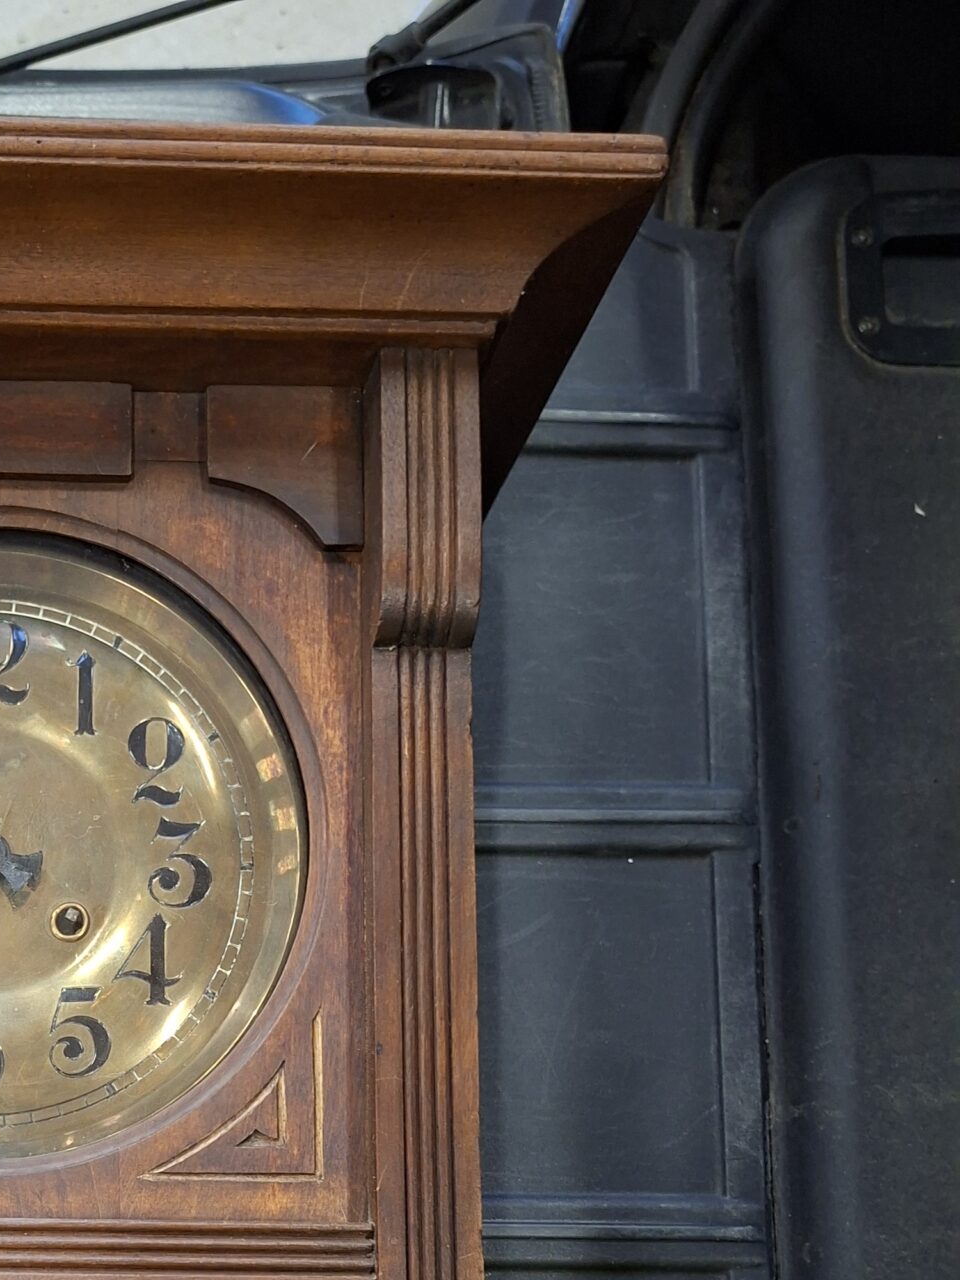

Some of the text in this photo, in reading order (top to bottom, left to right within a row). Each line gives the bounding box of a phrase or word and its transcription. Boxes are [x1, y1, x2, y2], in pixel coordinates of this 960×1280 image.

[66, 649, 98, 736] 1
[128, 716, 186, 807] 2
[147, 817, 213, 908] 3
[115, 913, 185, 1006] 4
[49, 985, 112, 1079] 5
